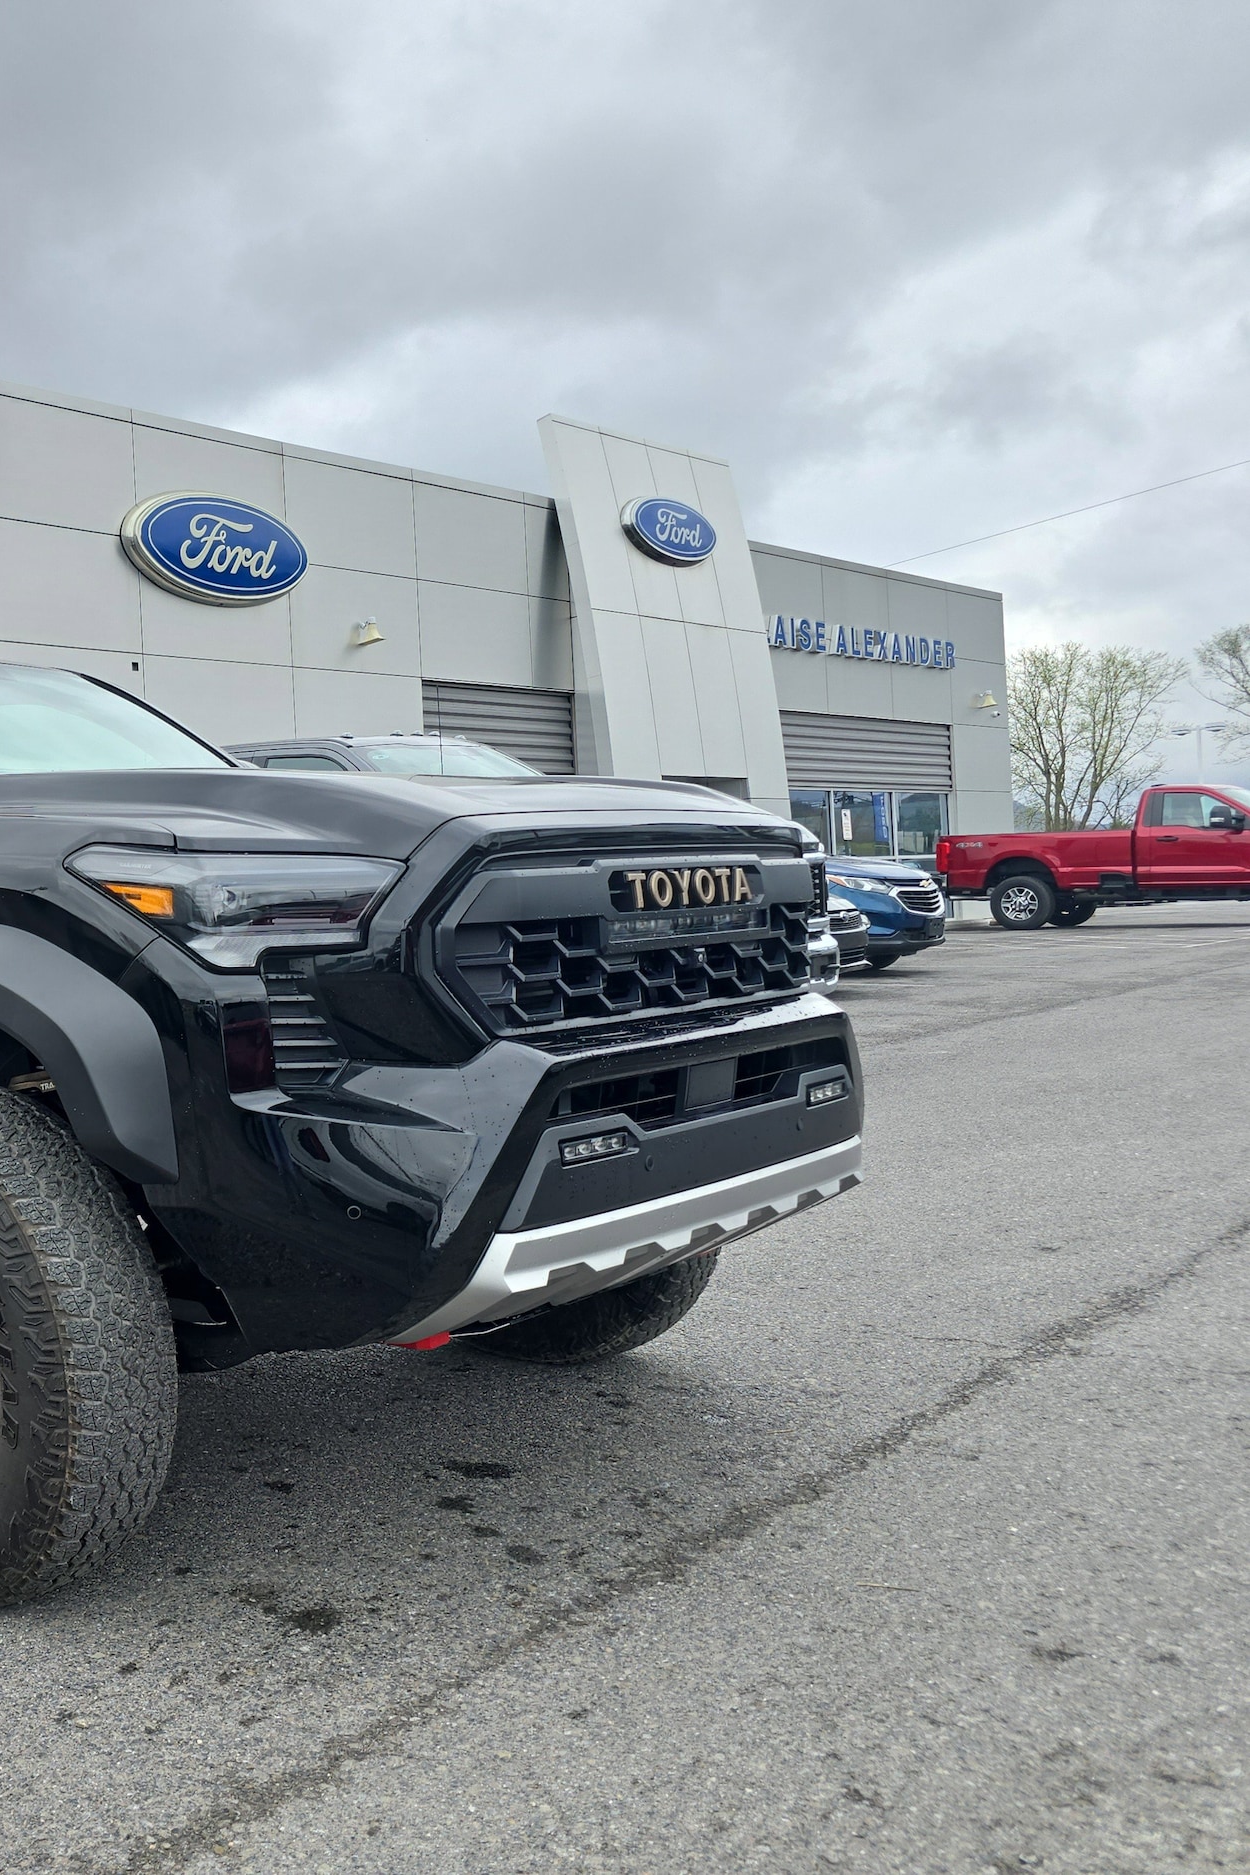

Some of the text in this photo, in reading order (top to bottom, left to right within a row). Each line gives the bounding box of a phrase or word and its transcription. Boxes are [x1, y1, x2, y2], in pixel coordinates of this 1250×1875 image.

[180, 513, 277, 579] Ford
[655, 508, 702, 548] Ford
[767, 614, 956, 669] AISE ALEXANDER
[625, 867, 753, 909] TOYOTA
